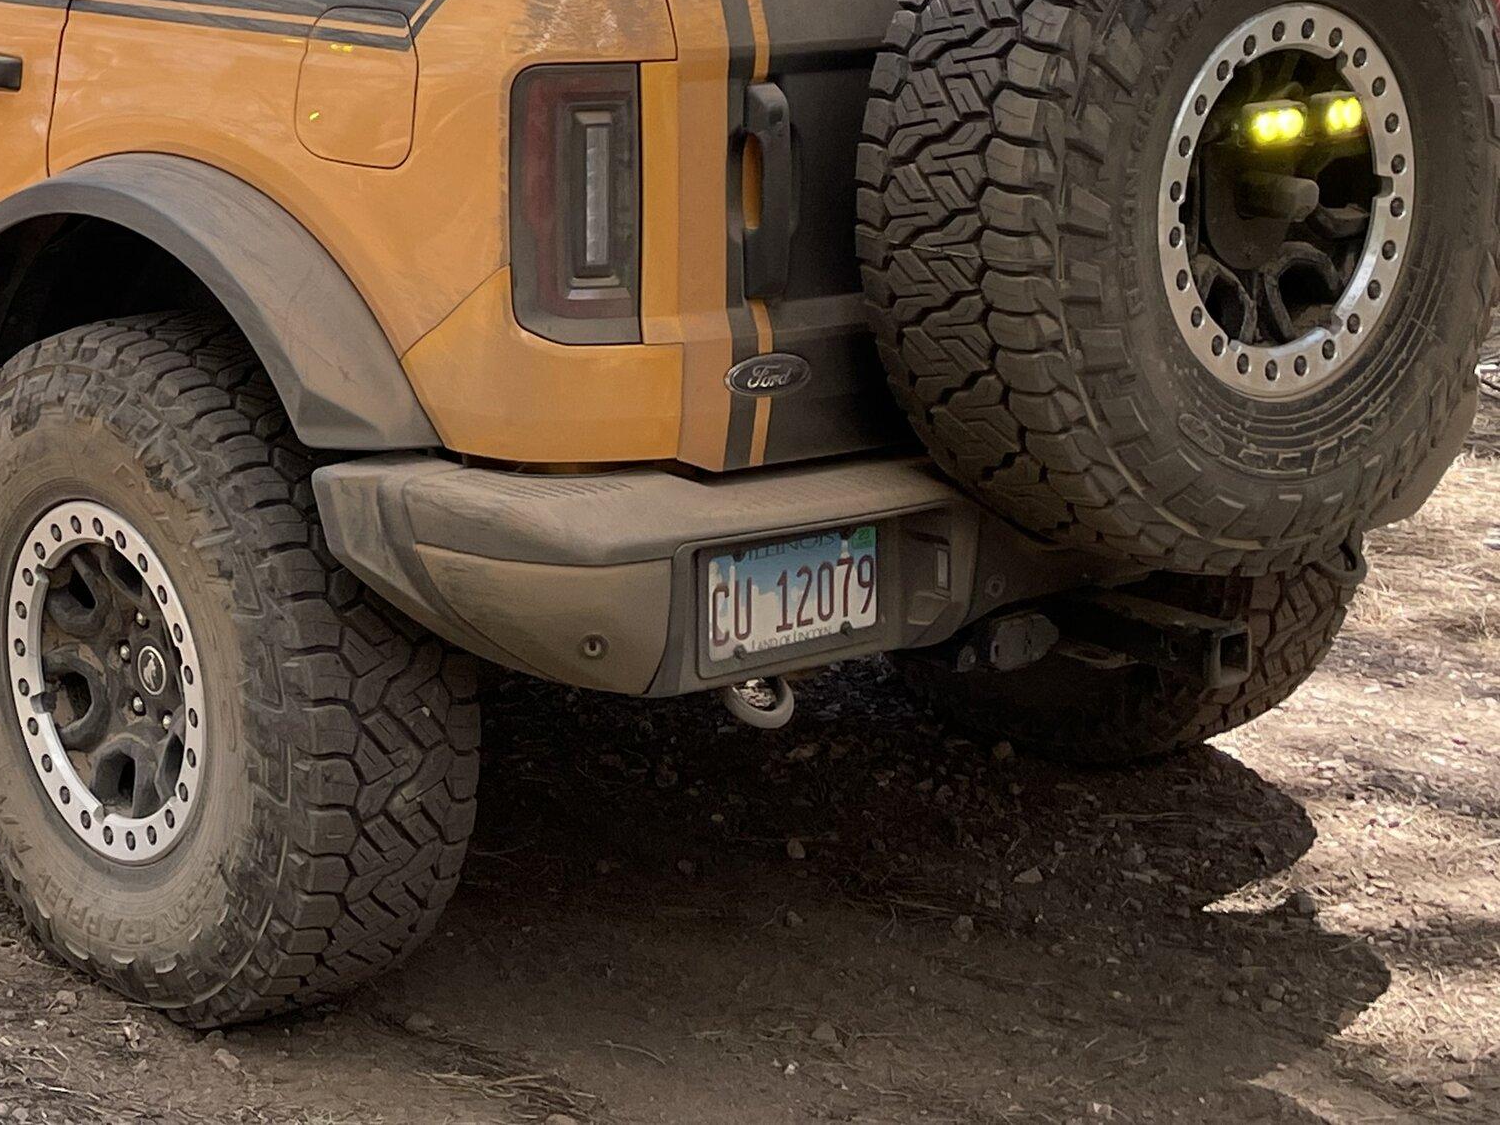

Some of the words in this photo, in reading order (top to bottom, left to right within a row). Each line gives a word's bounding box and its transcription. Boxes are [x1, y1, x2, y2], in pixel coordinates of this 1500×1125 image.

[747, 365, 793, 389] Ford
[712, 577, 752, 647] CU
[776, 554, 875, 633] 12079
